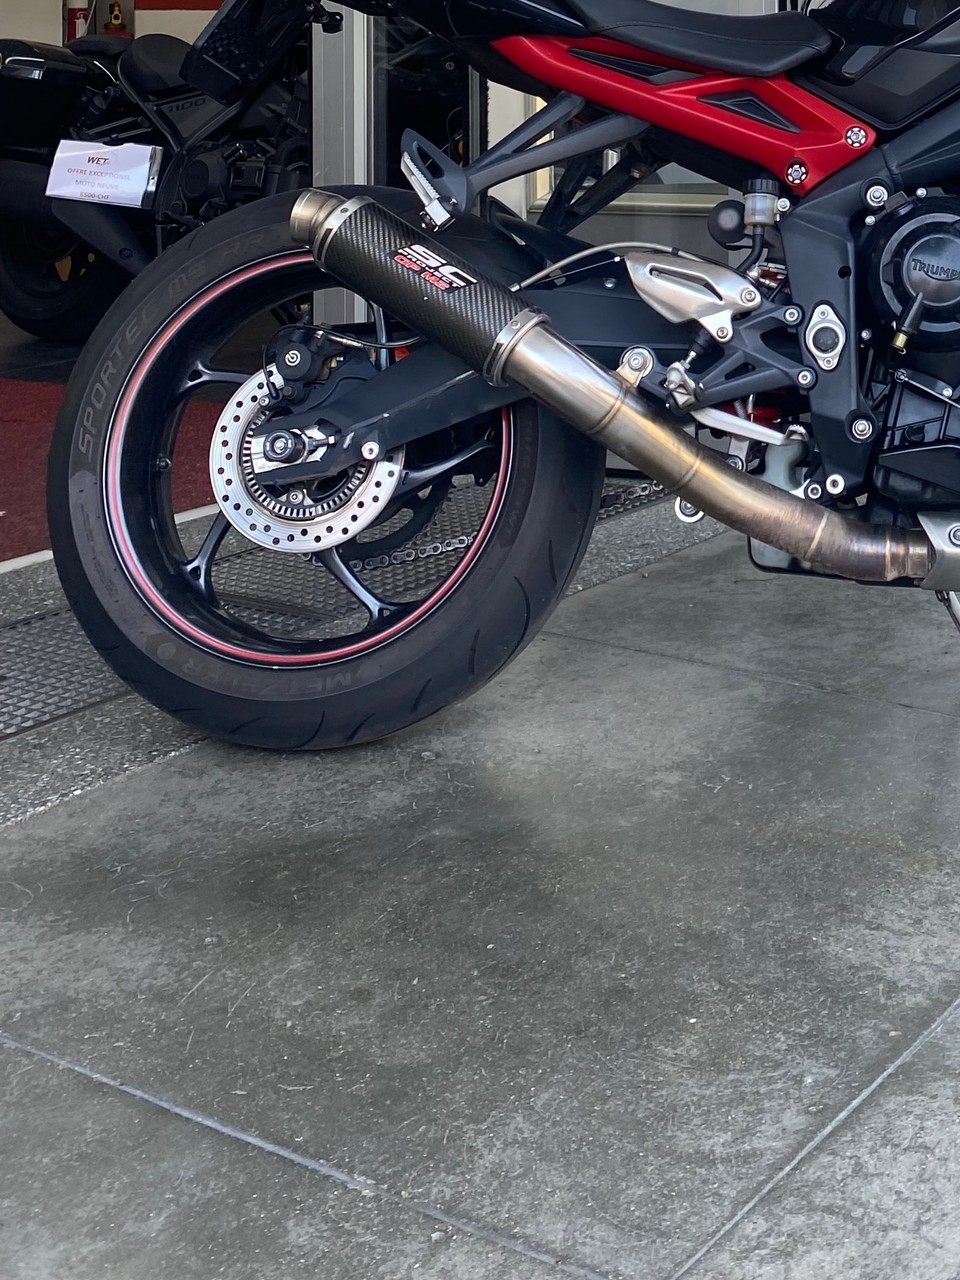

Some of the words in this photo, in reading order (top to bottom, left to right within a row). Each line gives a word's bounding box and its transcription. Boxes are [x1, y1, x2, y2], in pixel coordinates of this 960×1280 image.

[87, 155, 110, 165] WET
[67, 167, 88, 176] OFFRE
[75, 179, 95, 187] MOTO
